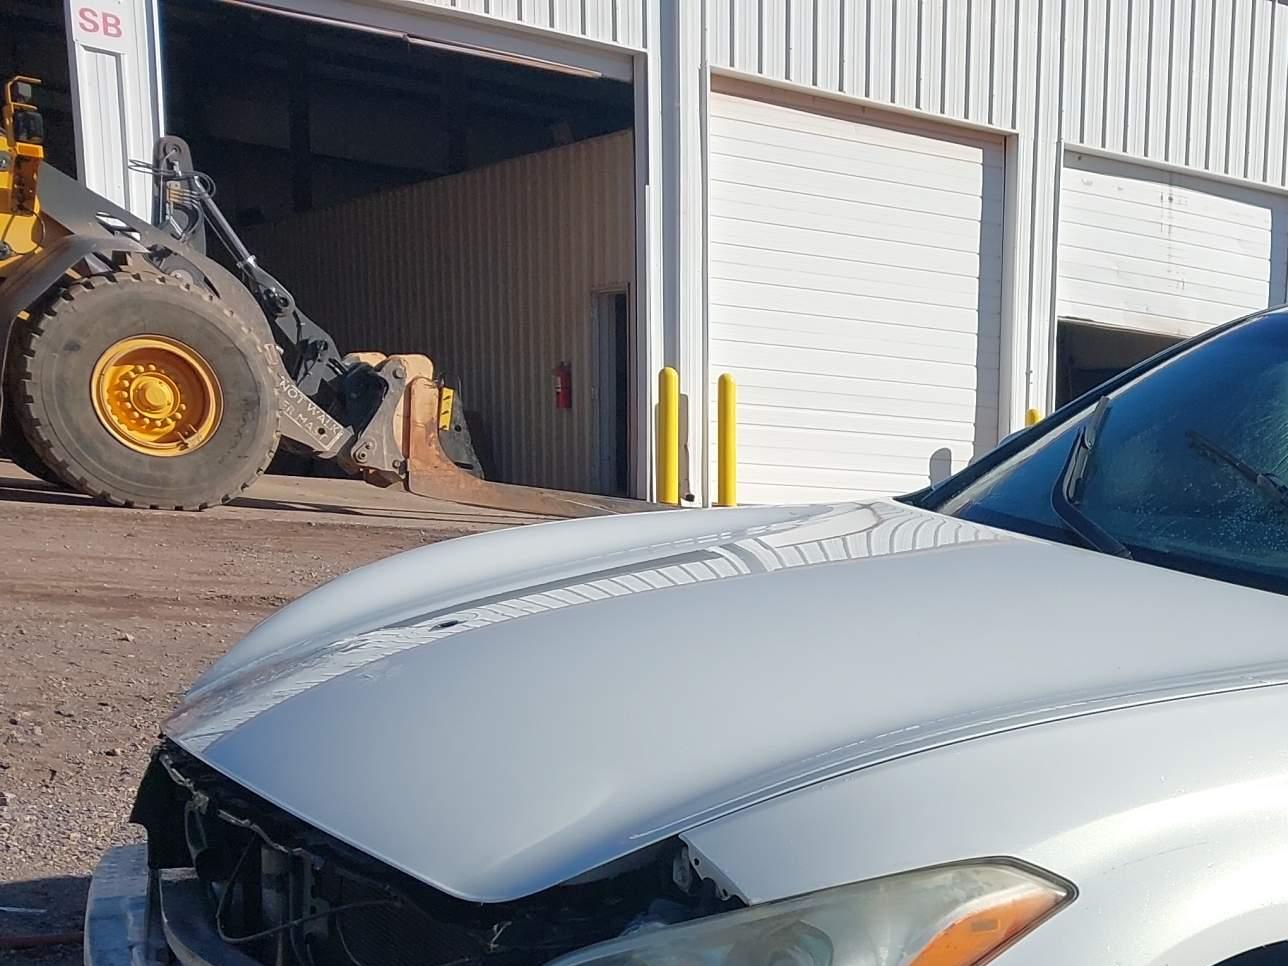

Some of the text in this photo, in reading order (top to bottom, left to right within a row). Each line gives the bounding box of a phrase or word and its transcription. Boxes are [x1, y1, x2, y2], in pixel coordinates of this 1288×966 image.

[79, 8, 122, 37] SB
[280, 380, 341, 435] NOT WALK
